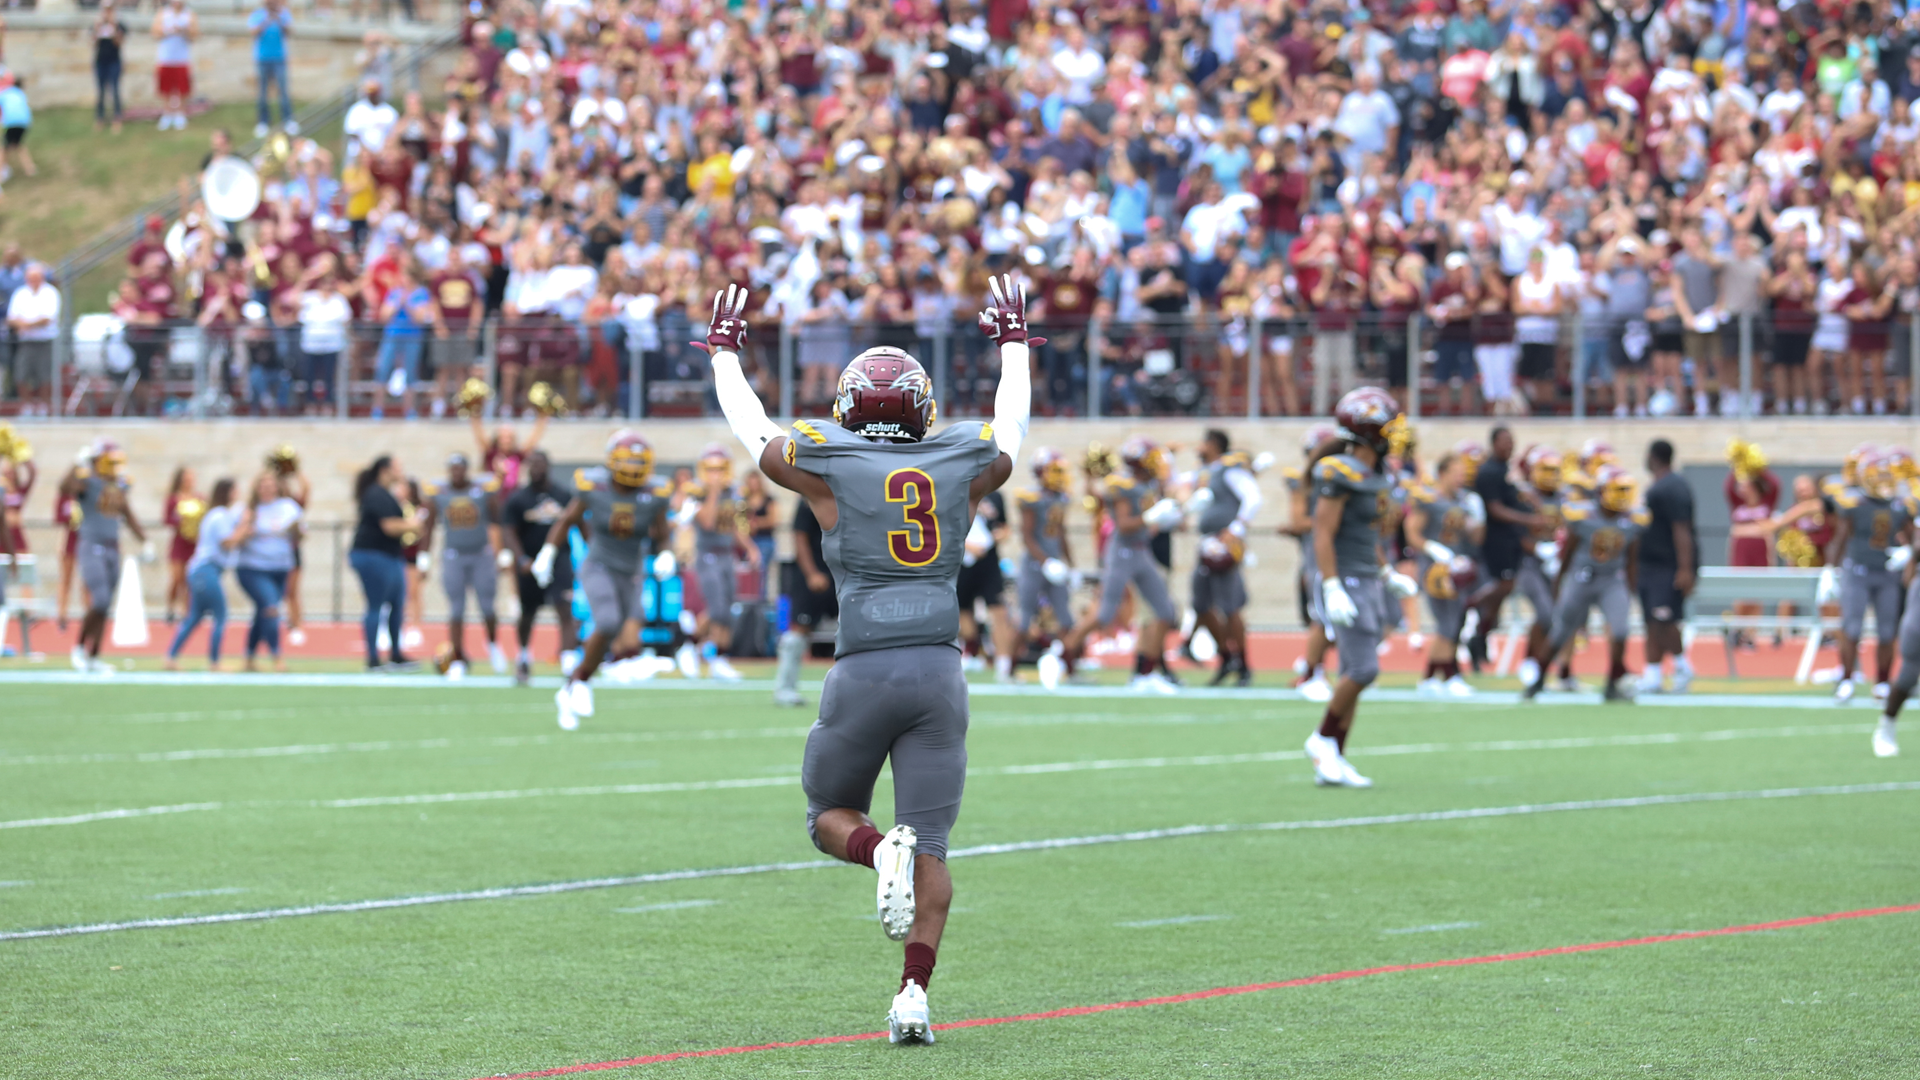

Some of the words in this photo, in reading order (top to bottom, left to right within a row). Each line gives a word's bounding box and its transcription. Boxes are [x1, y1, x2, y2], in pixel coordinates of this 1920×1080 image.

[865, 421, 901, 432] schutt
[784, 438, 797, 467] 3
[885, 467, 941, 567] 3
[871, 598, 932, 619] schutt
